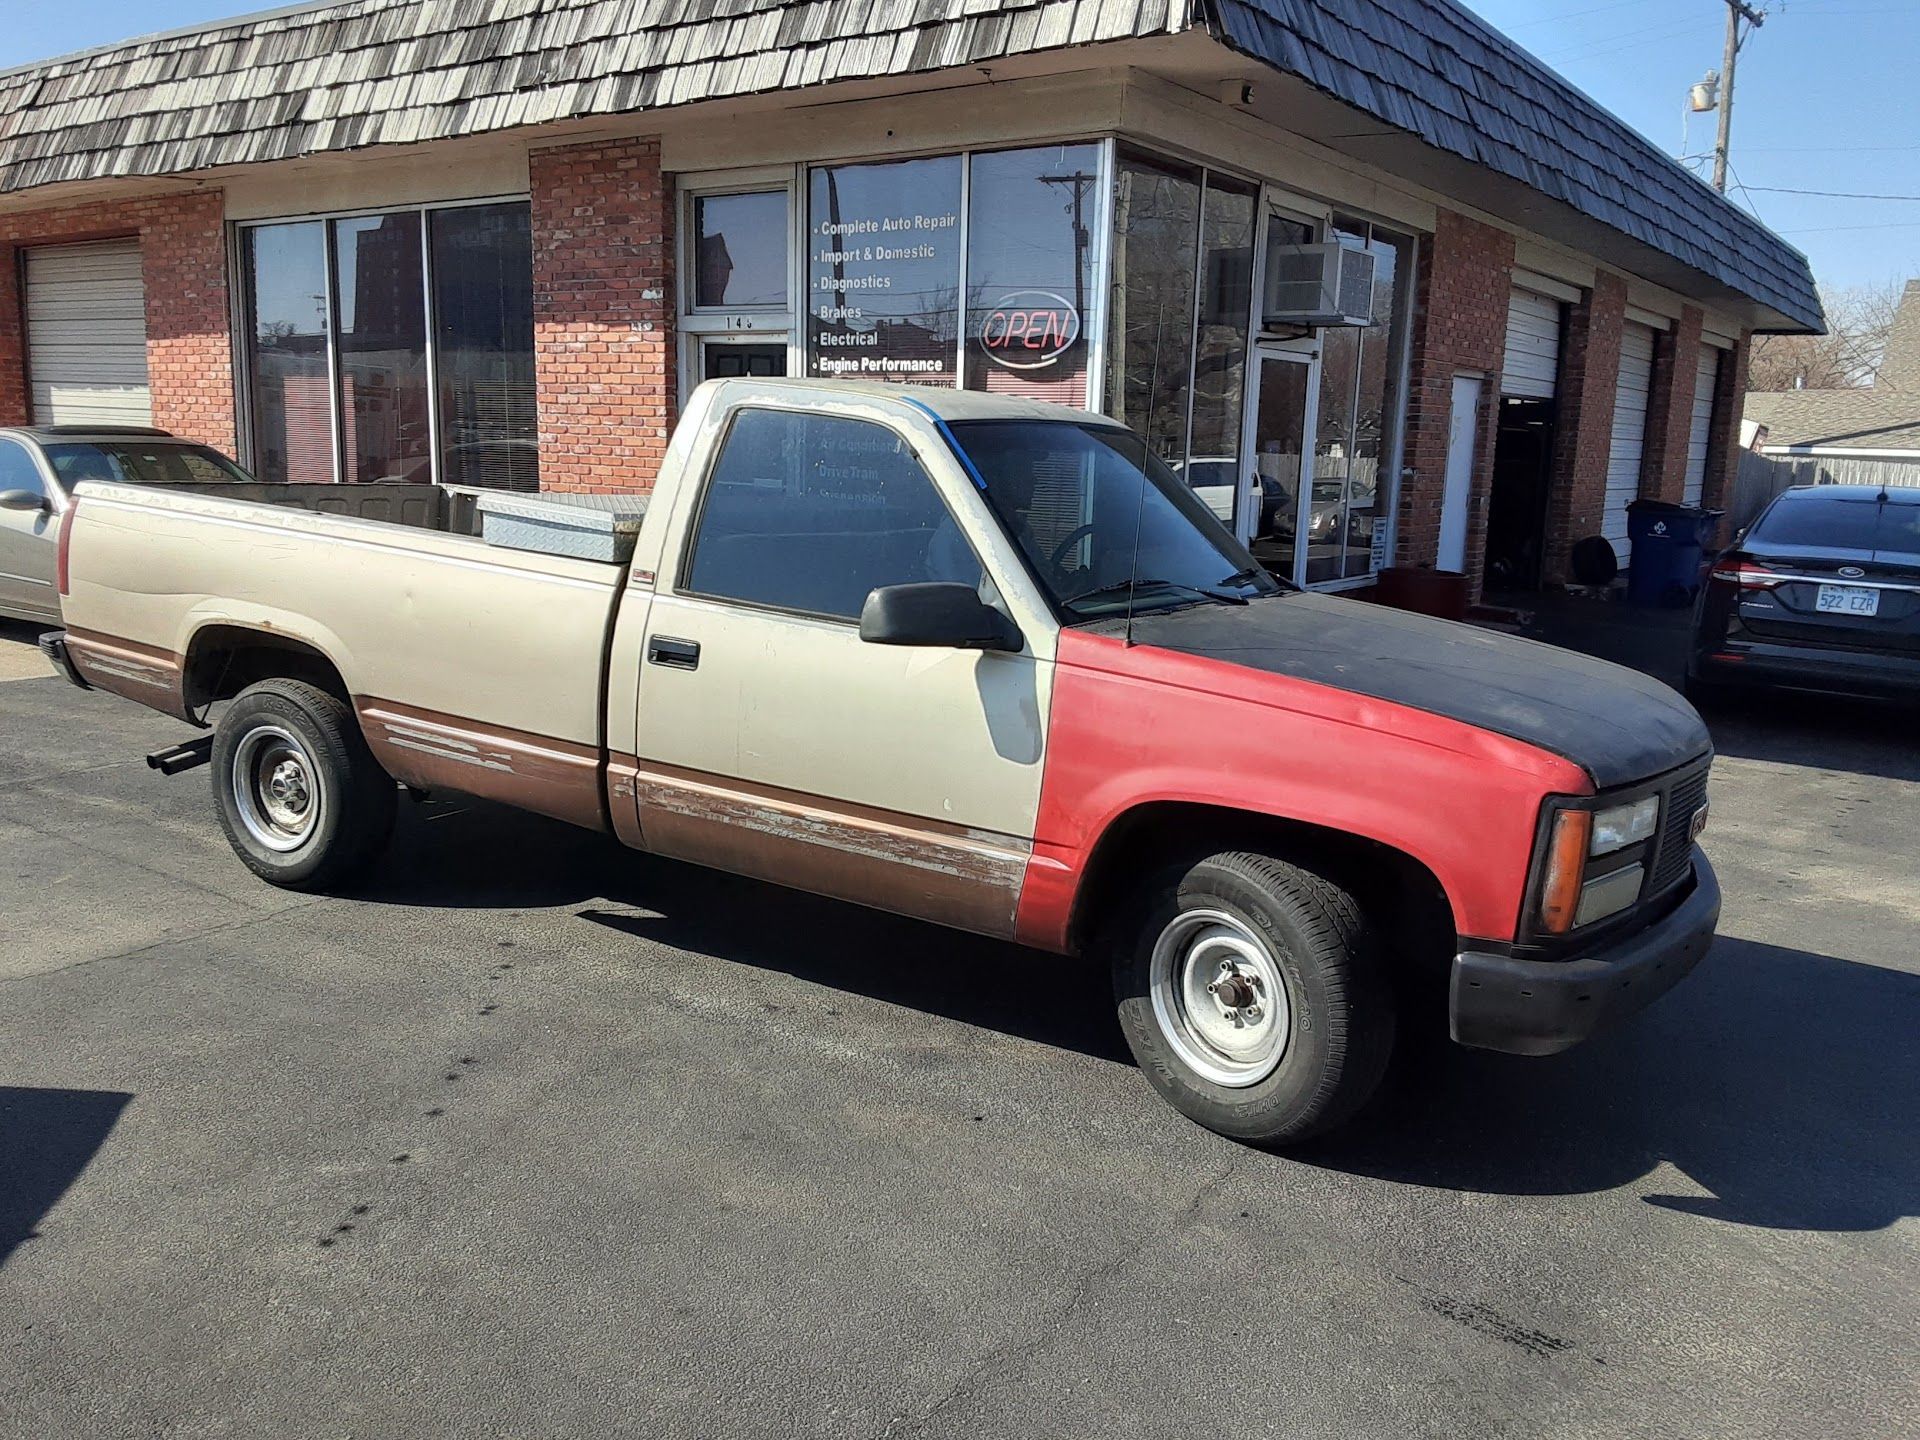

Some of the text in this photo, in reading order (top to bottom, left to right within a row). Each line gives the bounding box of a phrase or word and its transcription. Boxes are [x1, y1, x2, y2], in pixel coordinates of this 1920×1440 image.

[821, 212, 956, 236] Complete Auto Repair
[821, 243, 935, 265] Import & Domestic
[820, 274, 891, 293] Diagnostics
[820, 305, 862, 318] Brakes
[984, 311, 1070, 348] OPEN
[820, 332, 878, 346] Electrical
[820, 357, 943, 374] Engine Performance
[1821, 593, 1875, 611] 522 EZR
